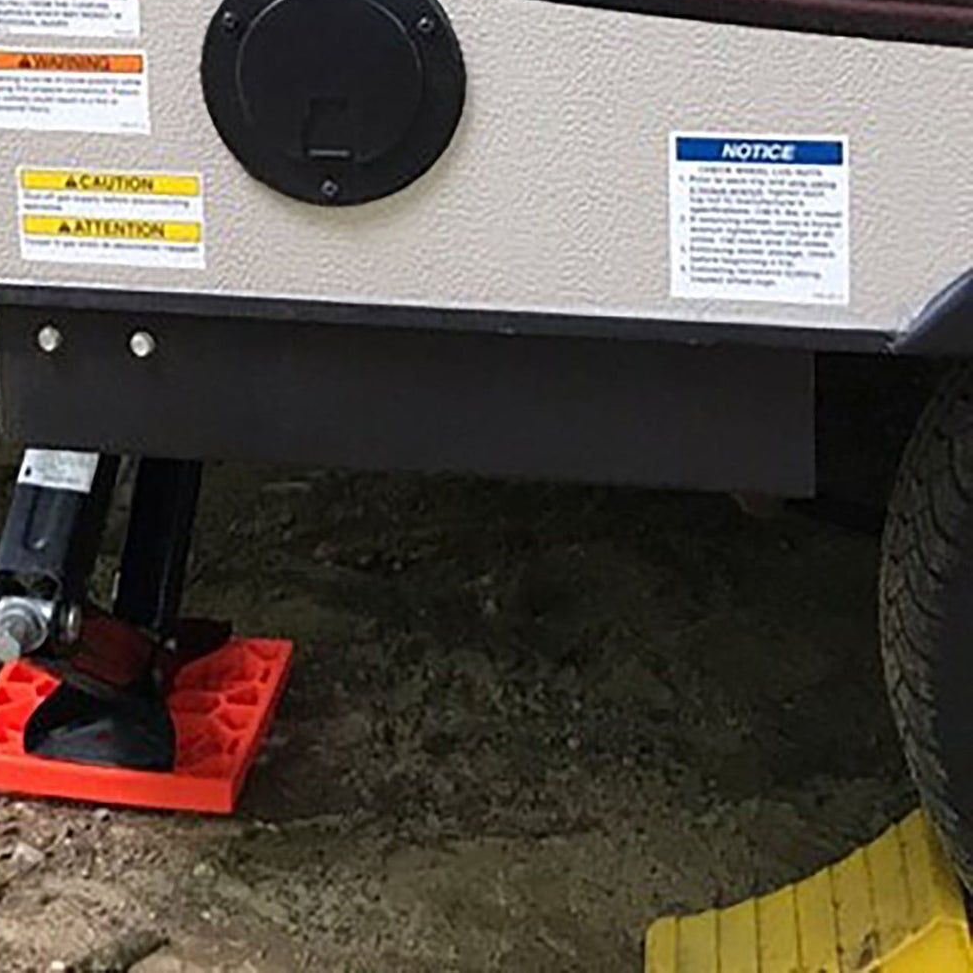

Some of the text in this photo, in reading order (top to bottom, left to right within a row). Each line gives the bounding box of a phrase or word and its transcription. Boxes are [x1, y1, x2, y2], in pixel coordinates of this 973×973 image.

[33, 54, 110, 70] WARNING
[721, 142, 796, 161] NOTICE
[78, 175, 154, 192] CAUTION
[74, 219, 165, 238] ATTENTION
